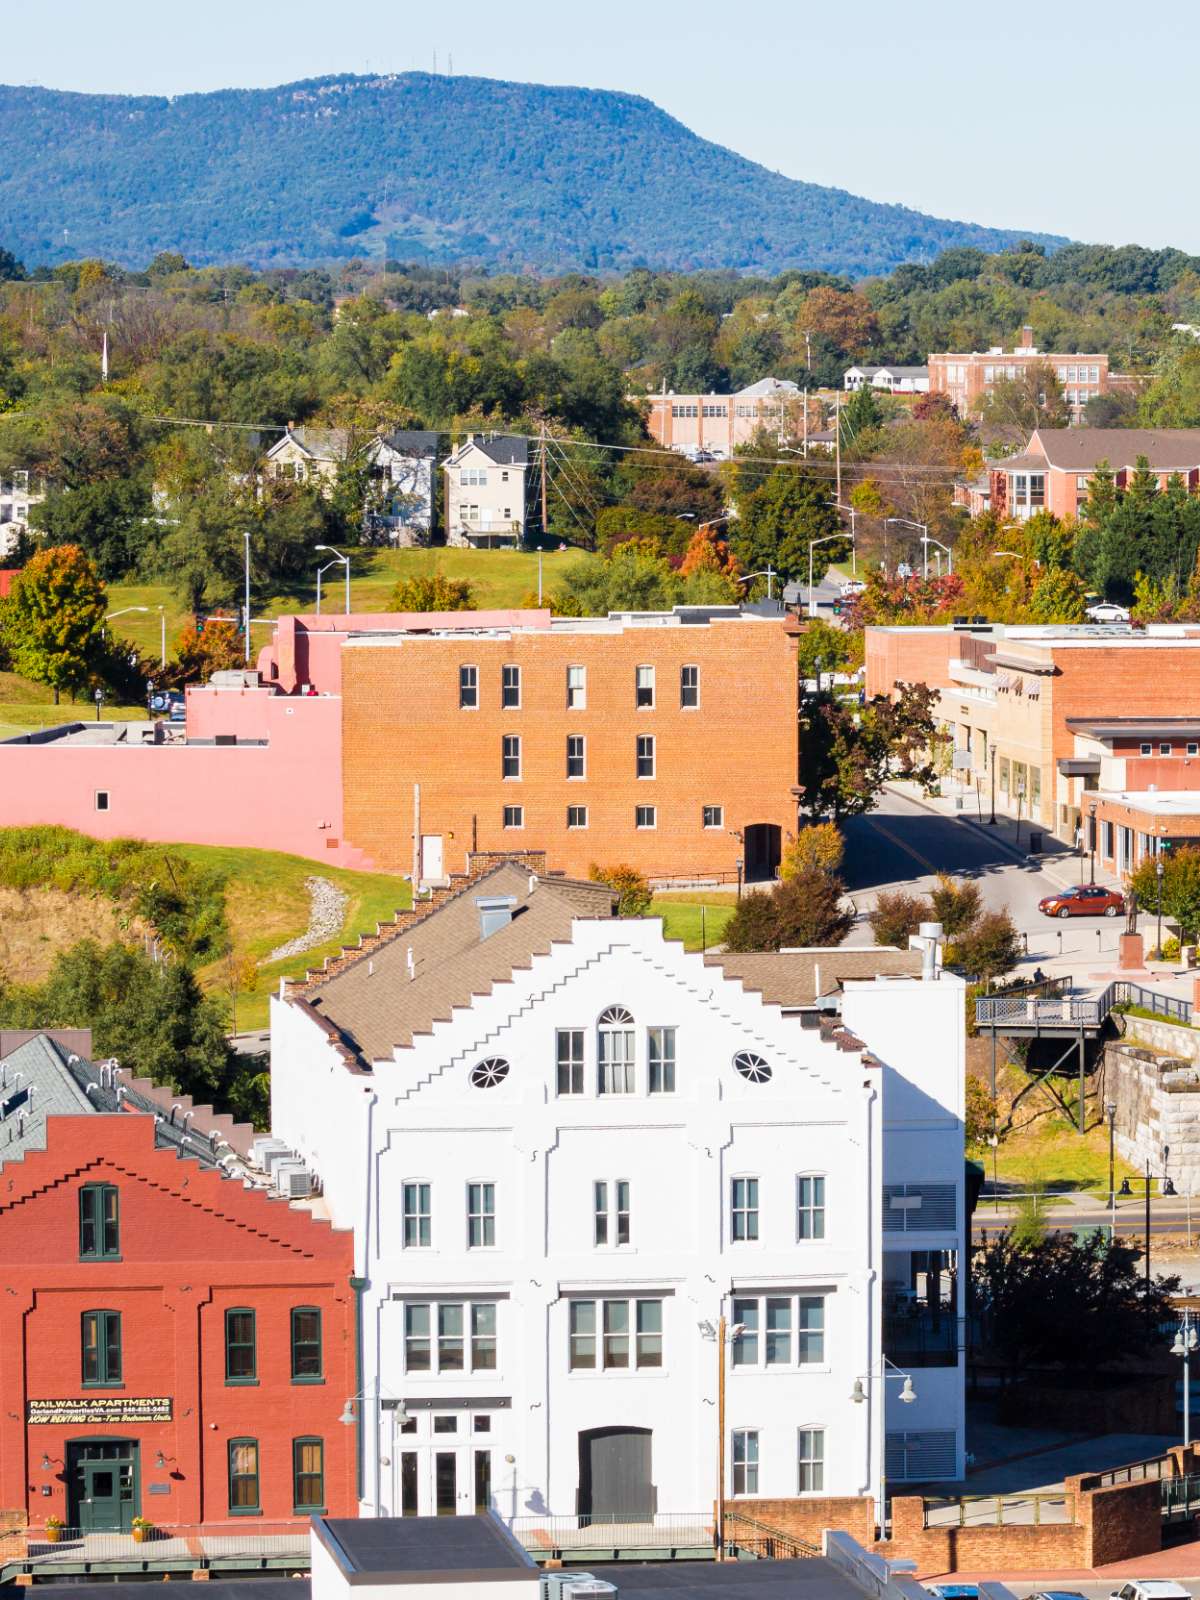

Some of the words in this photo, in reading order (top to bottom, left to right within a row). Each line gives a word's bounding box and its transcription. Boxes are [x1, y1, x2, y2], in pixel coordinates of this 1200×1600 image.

[30, 1400, 88, 1409] RAILWALK
[90, 1398, 170, 1408] APARTMENTS
[28, 1415, 48, 1424] NOW
[50, 1414, 86, 1424] RENTING
[153, 1412, 171, 1421] Units
